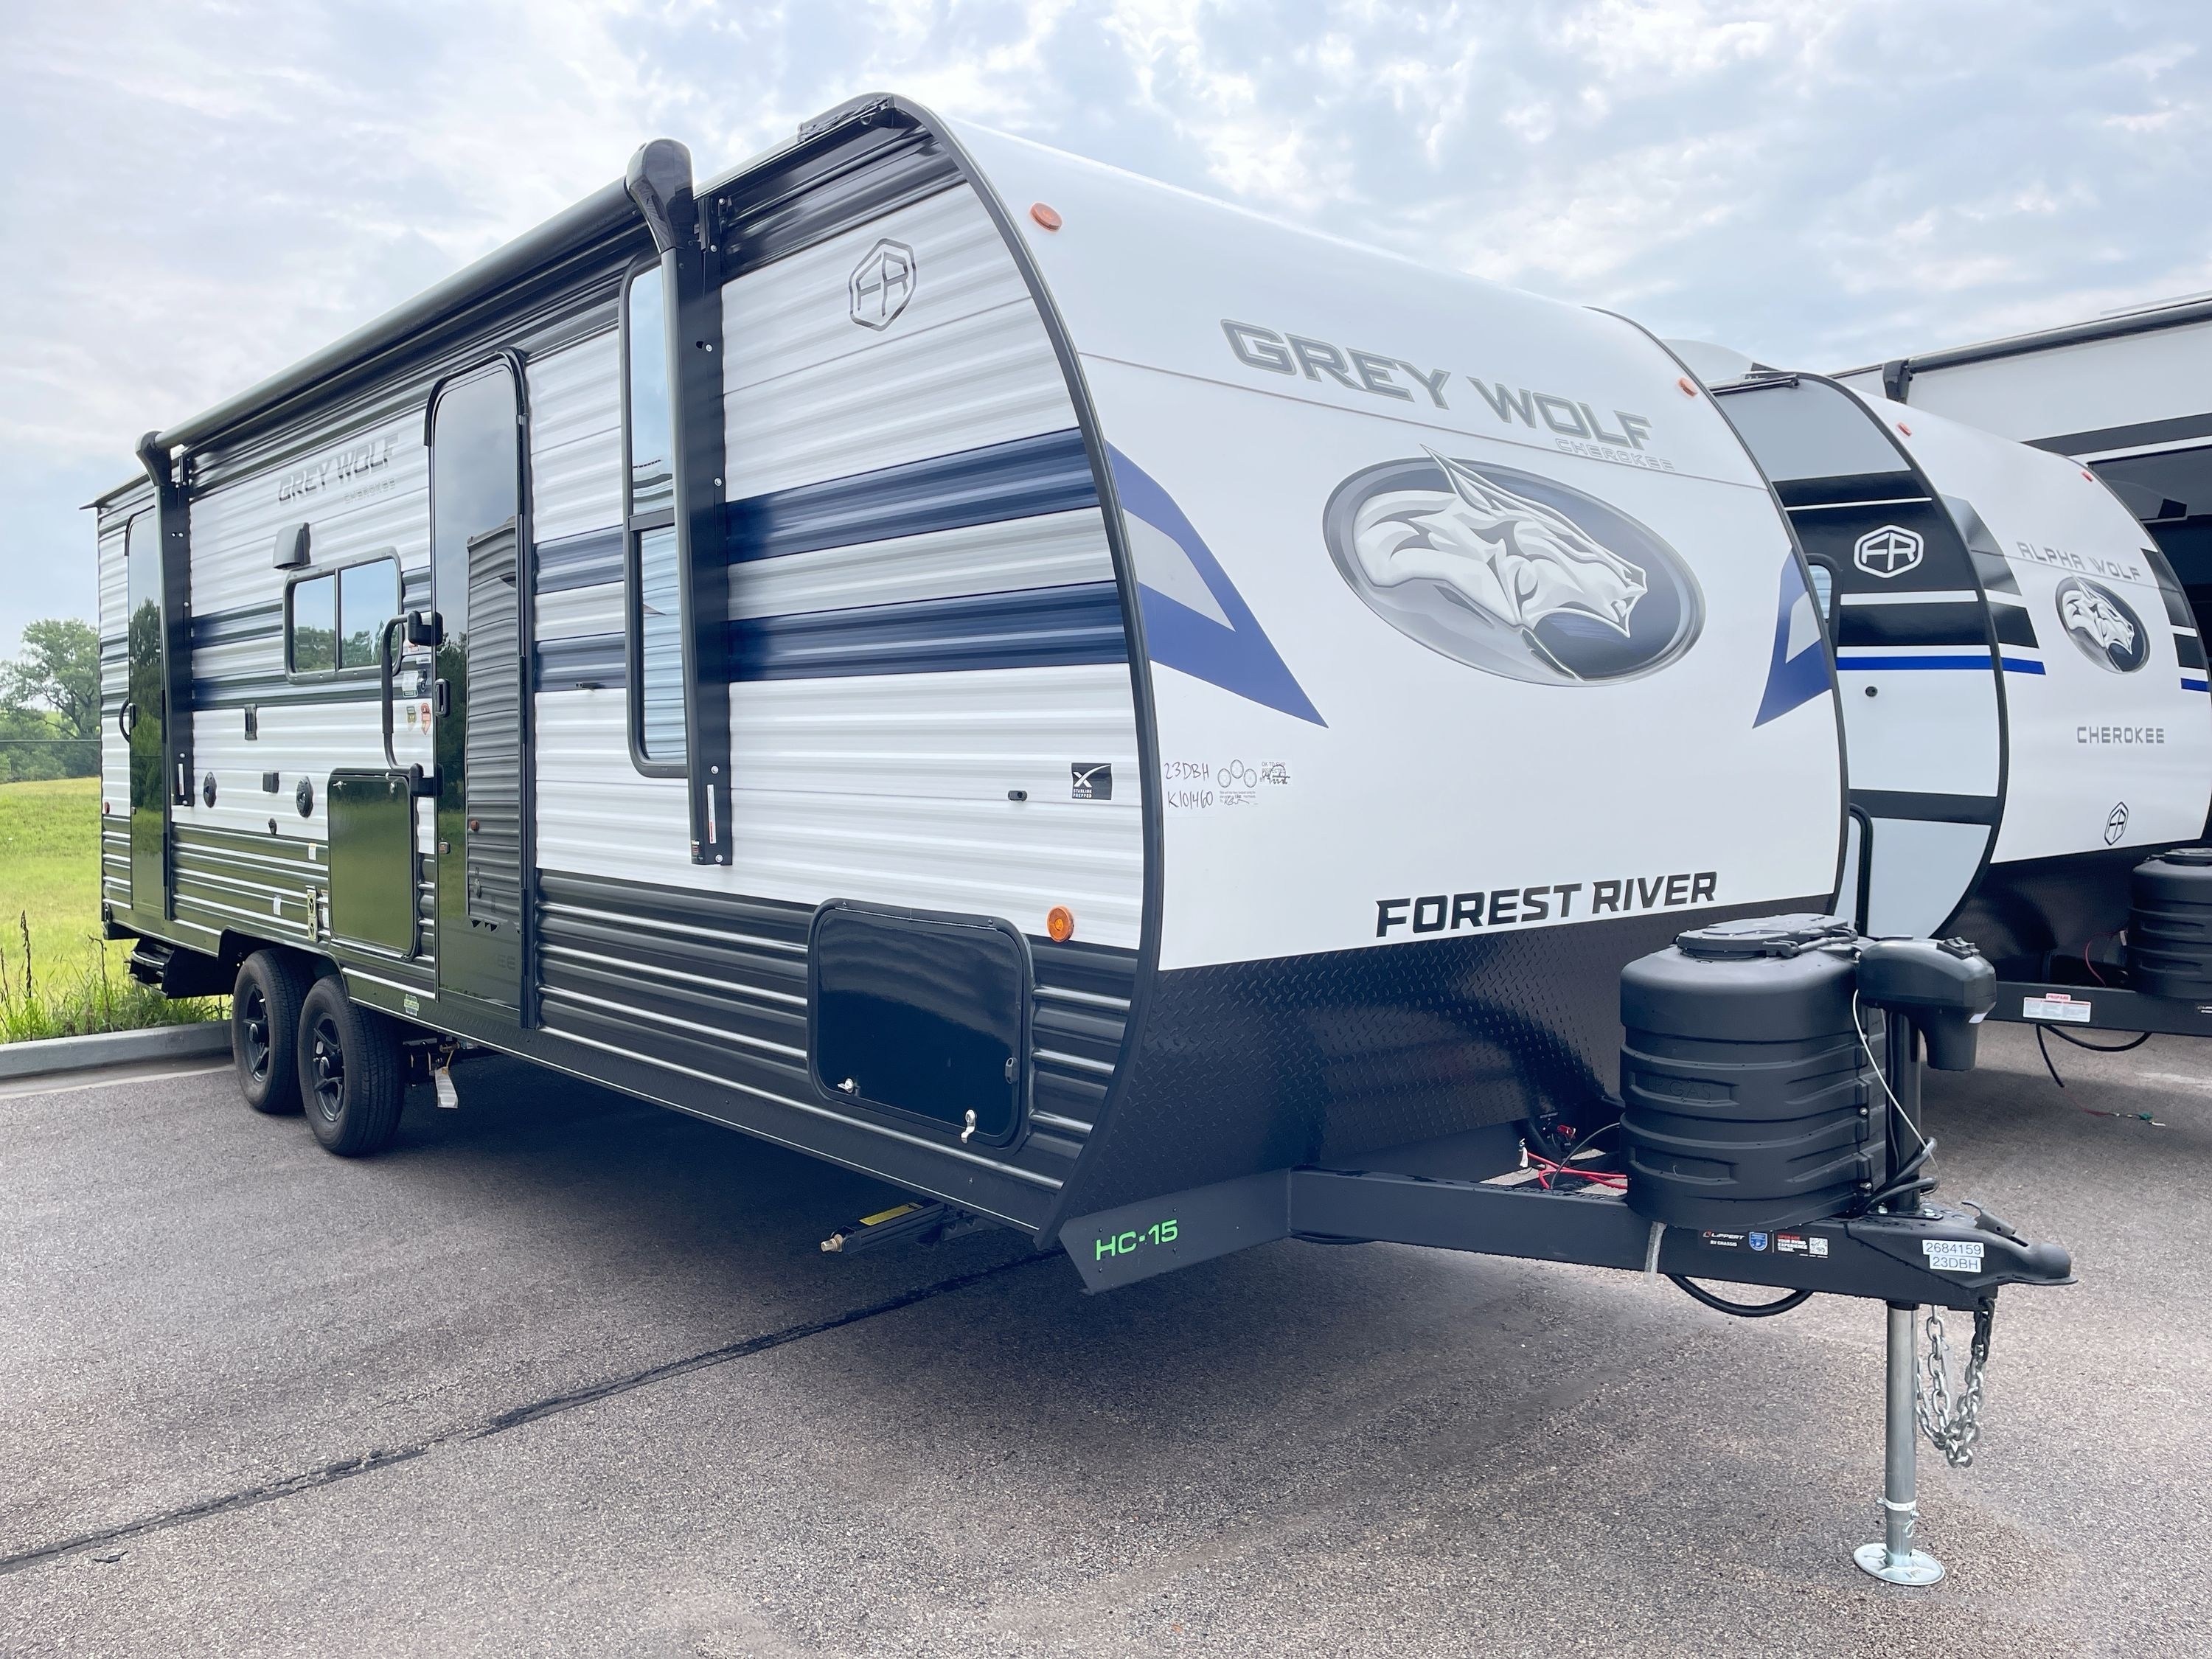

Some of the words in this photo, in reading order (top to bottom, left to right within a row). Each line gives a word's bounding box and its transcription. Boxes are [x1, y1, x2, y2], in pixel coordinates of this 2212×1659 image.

[1220, 319, 1451, 410] GREY
[1466, 376, 1652, 451] WOLF
[1554, 438, 1675, 471] CHEROKEE
[278, 460, 332, 507] GREY
[336, 432, 399, 484] WOLF
[2016, 540, 2087, 571] ALPHA
[2087, 556, 2140, 581] WOLF
[2076, 726, 2165, 744] CHEROKEE
[1164, 761, 1209, 782] 23DBH
[1375, 883, 1583, 938] FOREST
[1592, 871, 1718, 915] RIVER
[1669, 1081, 1711, 1100] GAS
[1926, 1242, 1982, 1255] 2684159
[1933, 1256, 1978, 1270] 23DBH
